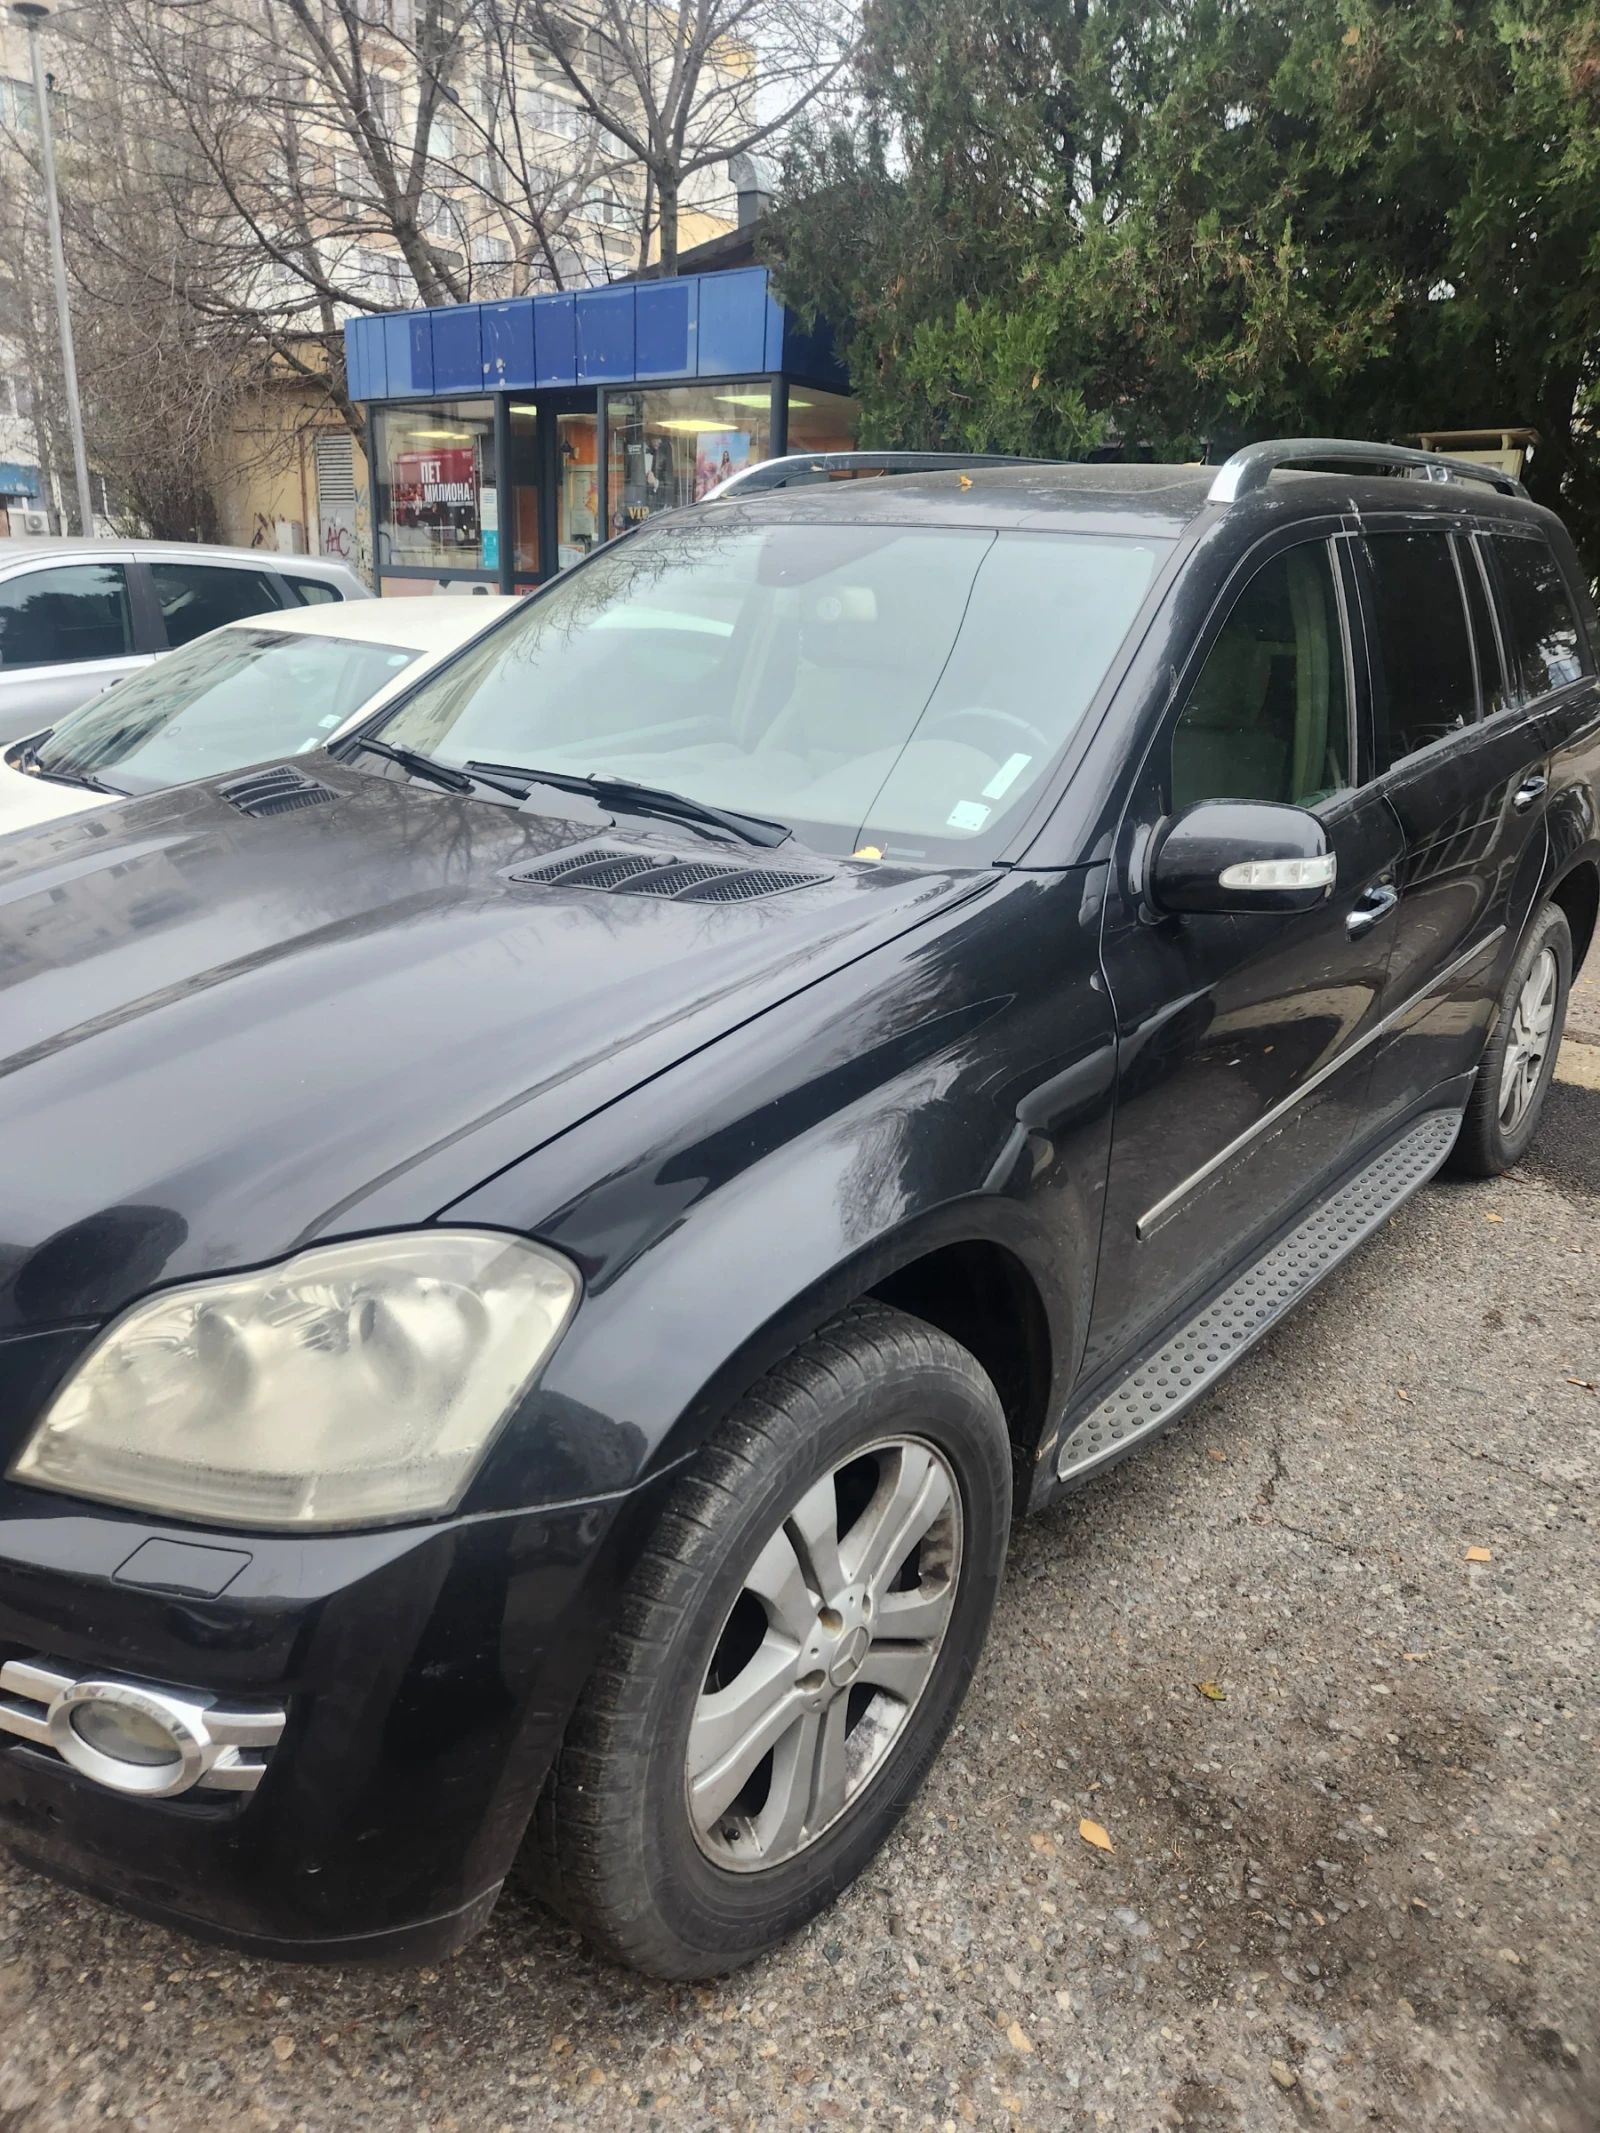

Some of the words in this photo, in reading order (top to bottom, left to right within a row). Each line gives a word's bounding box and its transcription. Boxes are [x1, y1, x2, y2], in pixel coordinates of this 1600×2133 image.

[421, 461, 441, 483] ПЕТ
[424, 482, 470, 502] МИЛИОНА
[628, 506, 650, 520] VIP
